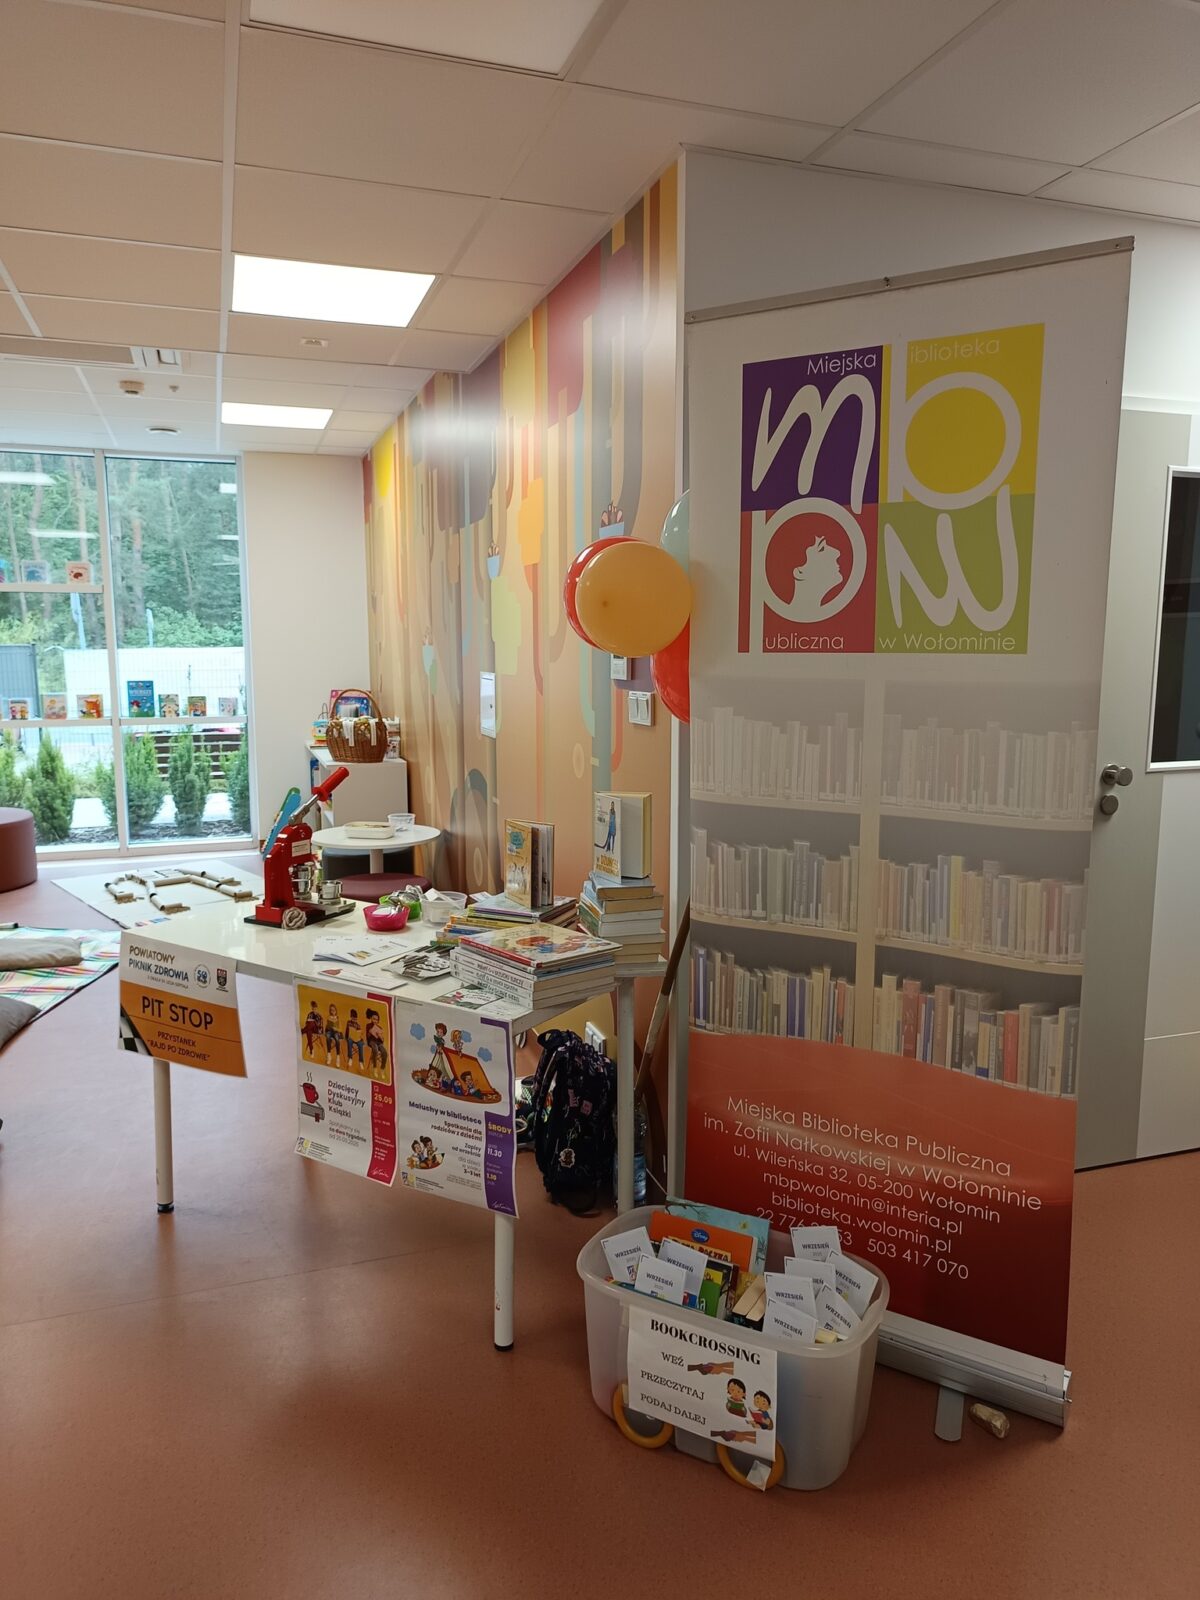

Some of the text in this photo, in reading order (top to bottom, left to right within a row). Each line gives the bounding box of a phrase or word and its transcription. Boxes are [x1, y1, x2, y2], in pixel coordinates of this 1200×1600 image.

[910, 338, 1000, 363] iblioteka
[807, 352, 877, 376] Miejska
[765, 633, 845, 649] ubliczna
[879, 633, 1016, 651] w Wołominie
[129, 945, 176, 965] POWIATOWY
[128, 958, 153, 973] PIKNIK
[154, 964, 189, 982] ZDROWIA
[141, 996, 214, 1031] PIT STOP
[157, 1031, 197, 1047] PRZYSTANEK
[167, 1045, 177, 1054] PO
[327, 1080, 359, 1096] Dziecięcy
[327, 1088, 366, 1108] Dyskusyjny
[327, 1097, 343, 1107] Klub
[328, 1105, 352, 1118] Książki
[408, 1100, 439, 1116] Maluchy
[446, 1110, 482, 1125] bibliotece
[431, 1124, 456, 1135] rodziców
[460, 1131, 483, 1142] dziećmi
[444, 1120, 473, 1133] Spotkania
[488, 1121, 512, 1135] ŚRODY
[727, 1096, 1011, 1177] Miejska Biblioteka Publiczna
[464, 1142, 482, 1153] Zapisy
[487, 1147, 503, 1158] 11.30
[704, 1112, 1042, 1210] im. Zofii Nałkowskiej w Wołominie
[733, 1144, 1000, 1224] ul. Wileńska 32, 05-200 Wołomin
[763, 1172, 963, 1235] mbpwolomin@interia.pl
[771, 1191, 952, 1253] biblioteka.wolomin.pl
[614, 1244, 642, 1259] WRZESIEŃ
[801, 1241, 830, 1250] WRZESIEŃ
[667, 1256, 694, 1273] WRZESIEŃ
[867, 1238, 897, 1258] 503
[902, 1249, 932, 1267] 417
[937, 1258, 969, 1279] 070
[646, 1272, 674, 1288] WRZESIEŃ
[774, 1291, 804, 1301] WRZESIEŃ
[825, 1303, 852, 1329] WRZESIEŃ
[773, 1317, 803, 1336] WRZESIEŃ
[650, 1318, 761, 1366] BOOKCROSSING
[660, 1351, 685, 1368] WEŹ
[640, 1369, 705, 1401] PRZECZYTAJ
[640, 1392, 707, 1426] PODAJ DALEJ
